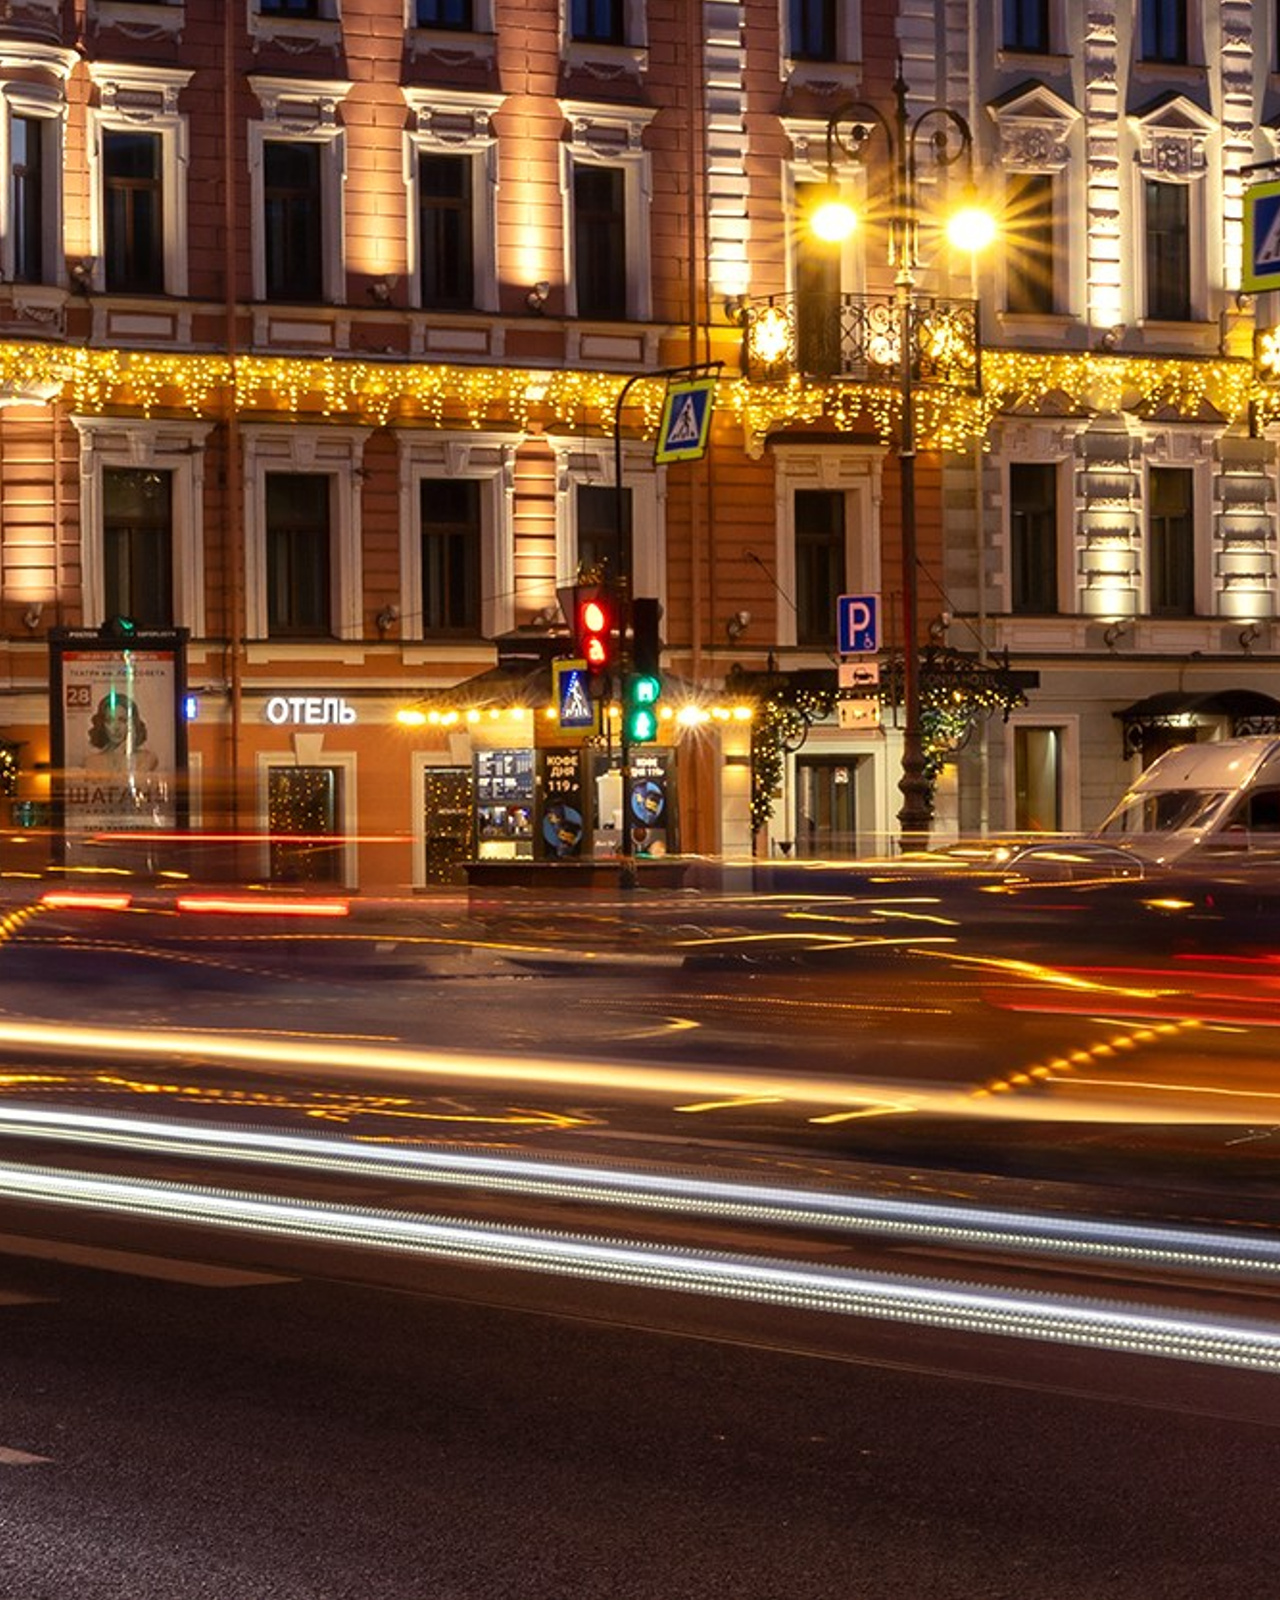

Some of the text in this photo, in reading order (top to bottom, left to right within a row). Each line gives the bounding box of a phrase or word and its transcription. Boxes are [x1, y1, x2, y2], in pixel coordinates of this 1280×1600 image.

[848, 602, 870, 647] P
[67, 689, 90, 704] 28
[267, 697, 357, 725] ОТЕЛЬ
[546, 756, 579, 767] КОФЕ
[550, 766, 575, 778] ДНЯ
[548, 780, 571, 791] 119
